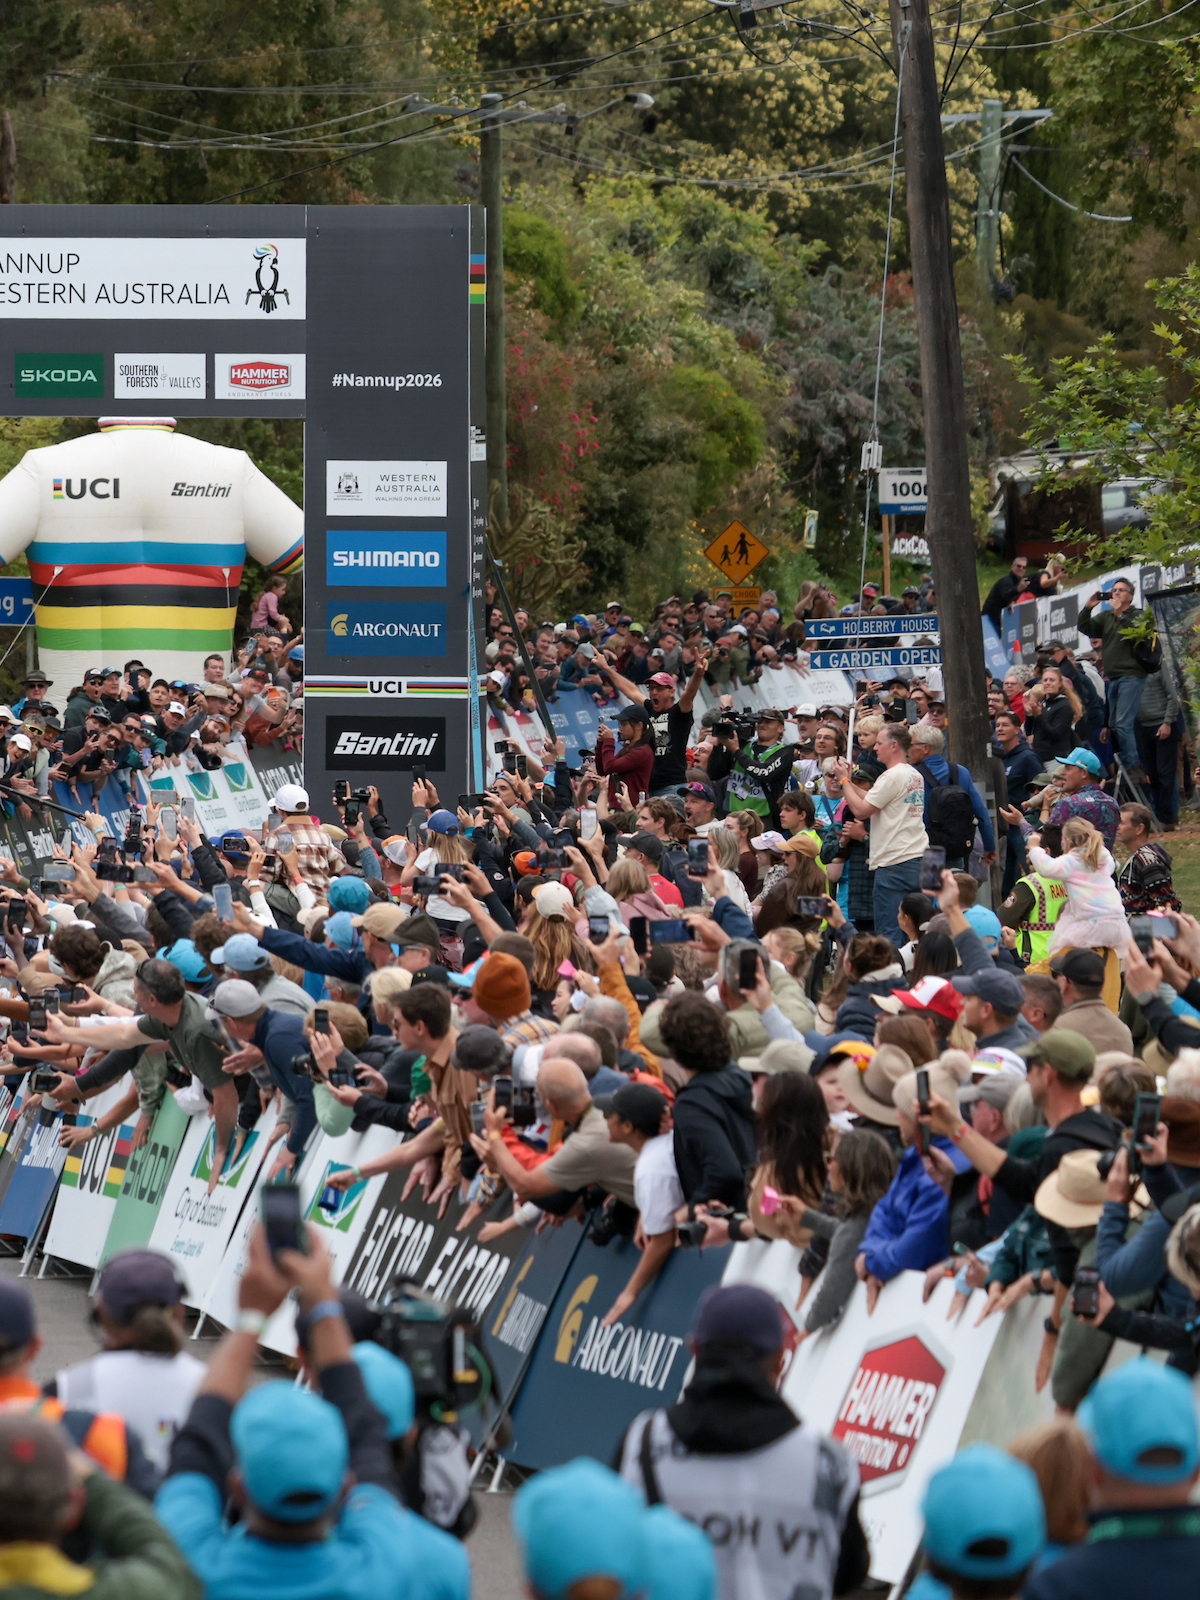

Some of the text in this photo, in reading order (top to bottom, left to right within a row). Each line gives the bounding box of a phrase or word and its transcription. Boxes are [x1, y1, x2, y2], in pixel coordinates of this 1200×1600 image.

[95, 283, 230, 304] AUSTRALIA
[119, 365, 159, 376] SOUTHERN
[231, 368, 289, 379] HAMMER
[126, 377, 159, 388] FORESTS
[169, 377, 201, 389] VALLEYS
[331, 372, 443, 391] #Nannup2026
[379, 474, 437, 482] WESTERN
[65, 477, 120, 500] UCI
[170, 481, 233, 499] Santini
[375, 484, 441, 493] AUSTRALIA
[333, 550, 440, 567] SHIMANO
[352, 623, 442, 637] ARGONAUT
[842, 619, 936, 634] HOLBERRY HOUSE
[829, 649, 940, 668] GARDEN OPEN
[369, 680, 402, 694] UCI
[333, 731, 439, 756] Santini
[348, 1204, 436, 1308] FACTOR
[421, 1234, 511, 1327] FACTOR
[572, 1316, 684, 1392] ARGONAUT
[838, 1366, 938, 1440] HAMMER
